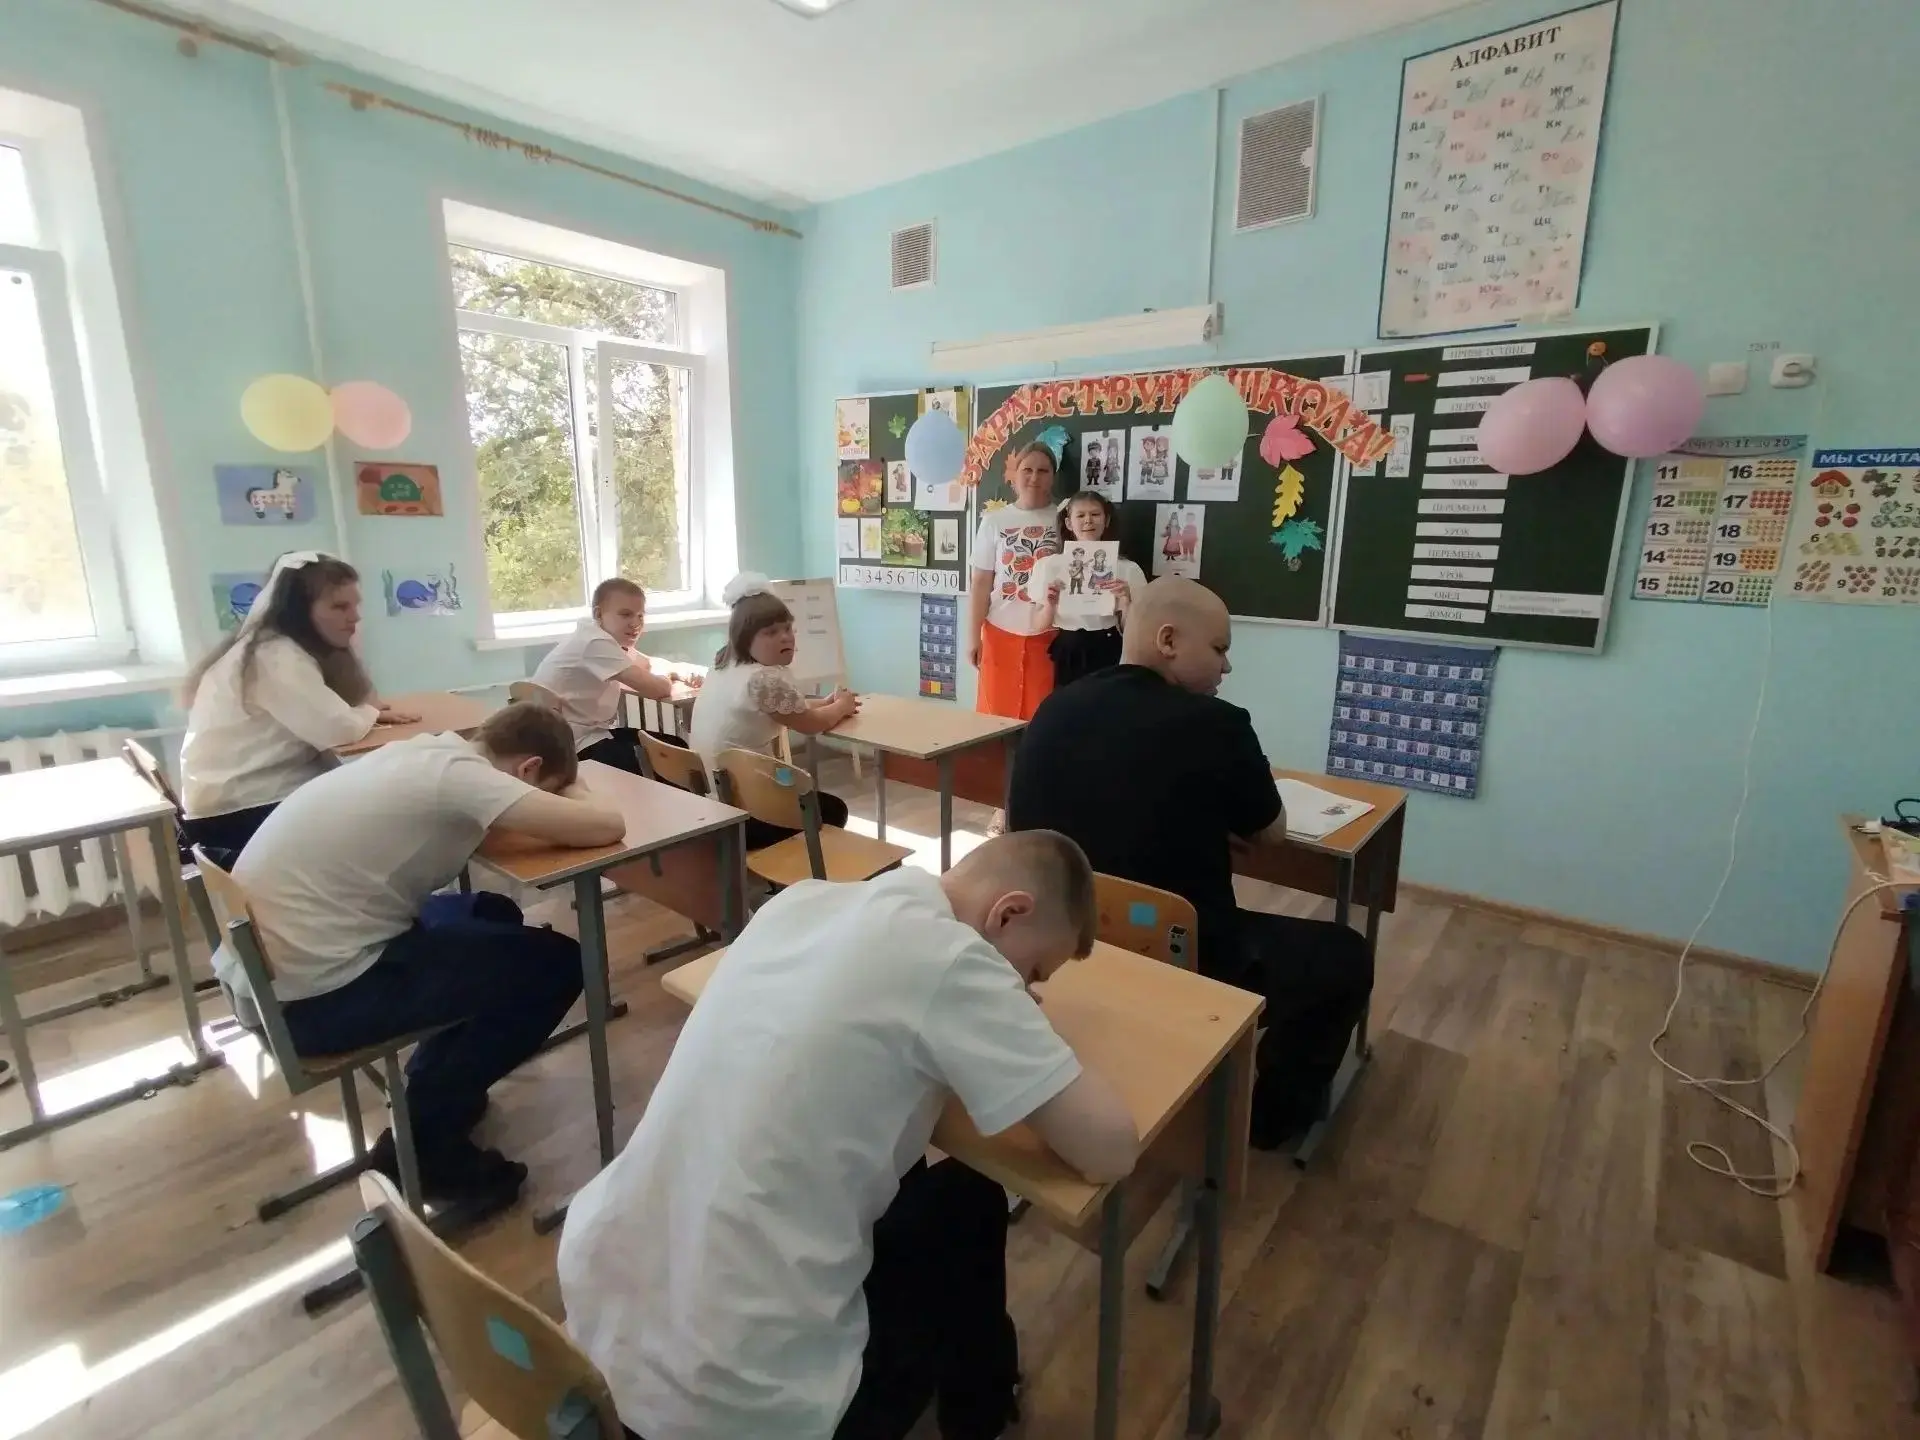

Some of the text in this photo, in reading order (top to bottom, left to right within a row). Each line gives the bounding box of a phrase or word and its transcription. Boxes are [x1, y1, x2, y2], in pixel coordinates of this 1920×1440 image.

[1450, 26, 1562, 71] АЛФАВИТ
[1820, 453, 1854, 464] МЫ
[1657, 465, 1679, 480] 11
[1729, 464, 1753, 480] 16
[1892, 472, 1902, 483] 2
[1652, 494, 1676, 508] 12
[1723, 494, 1749, 509] 17
[1904, 503, 1914, 512] 5
[1833, 511, 1842, 520] 4
[1648, 522, 1671, 537] 13
[1716, 523, 1742, 539] 18
[1810, 533, 1820, 543] 6
[1893, 536, 1904, 546] 7
[1428, 548, 1482, 559] ПЕРЕМЕНА
[1644, 550, 1666, 564] 14
[1713, 552, 1737, 567] 19
[855, 568, 861, 582] 2
[865, 569, 872, 584] 3
[874, 570, 882, 584] 4
[886, 570, 893, 584] 5
[897, 571, 905, 585] 6
[908, 572, 915, 584] 7
[920, 572, 928, 587] 8
[931, 573, 940, 588] 9
[943, 573, 958, 588] 10
[1638, 577, 1661, 591] 15
[1837, 579, 1847, 589] 9
[1705, 580, 1734, 595] 20
[1793, 581, 1803, 591] 8
[1882, 586, 1897, 597] 10
